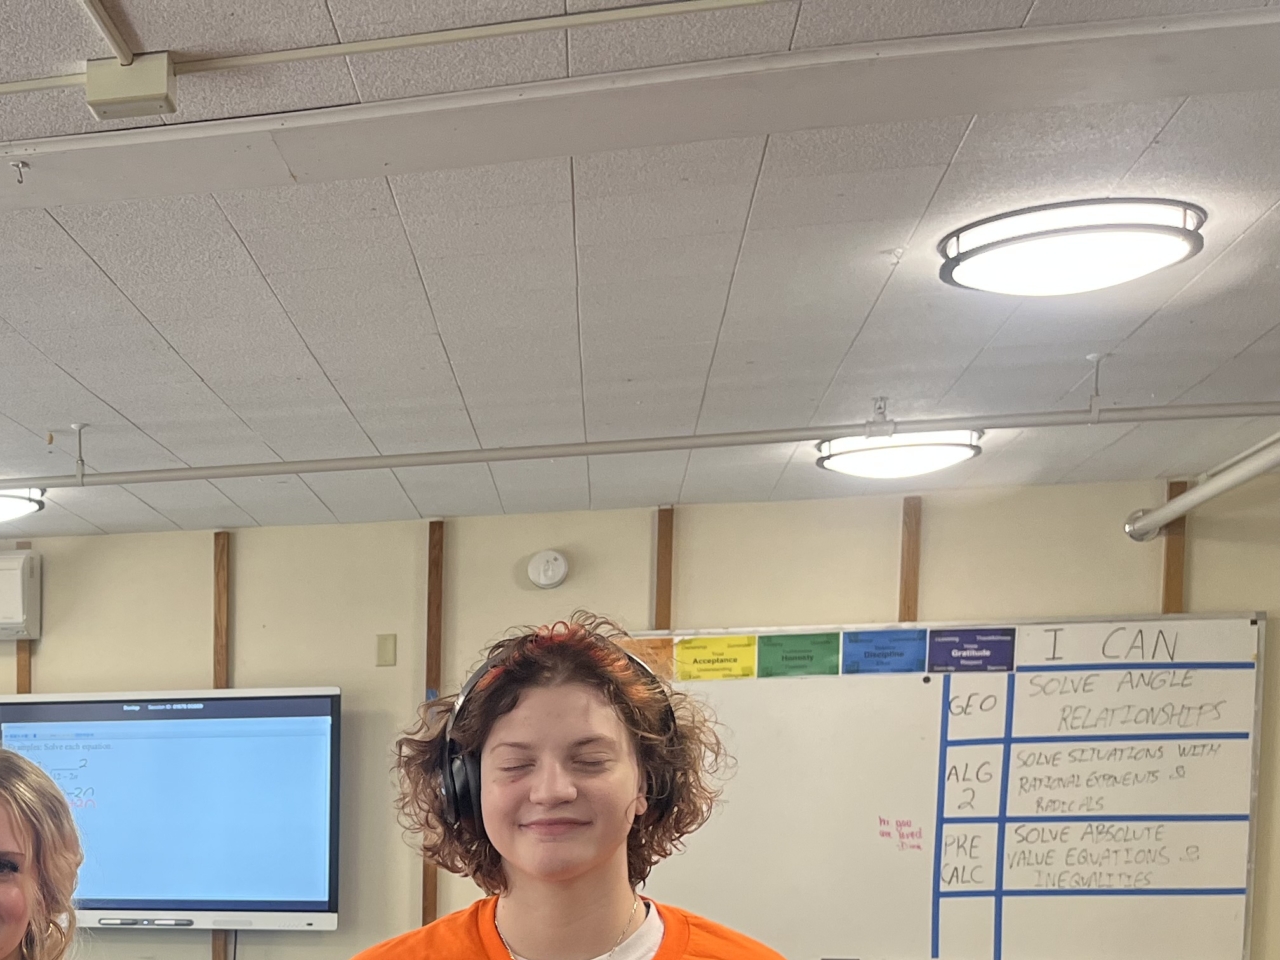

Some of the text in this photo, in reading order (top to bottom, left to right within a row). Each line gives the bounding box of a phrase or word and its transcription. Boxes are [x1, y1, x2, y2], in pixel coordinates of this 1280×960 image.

[863, 650, 905, 659] Discipline
[951, 648, 991, 658] Gratitude
[1043, 627, 1178, 662] I CAN
[693, 657, 738, 665] Acceptance
[1029, 669, 1198, 697] SOLVE ANGLE
[949, 693, 997, 716] GEO
[1057, 700, 1227, 732] RELATIONSHIPS
[1016, 743, 1222, 769] SOLVE SITUATIONS WITH
[947, 760, 993, 783] ALG
[1018, 773, 1082, 796] RATIONAL
[958, 787, 975, 810] 2
[1035, 796, 1104, 814] RADICALS
[1014, 823, 1165, 844] SOLVE ABSOLUTE
[944, 833, 981, 859] PRE
[1007, 848, 1056, 869] VALUE
[1065, 846, 1170, 867] EQUATIONS
[941, 863, 985, 886] CALC
[1033, 870, 1153, 888] INEQUALITIES
